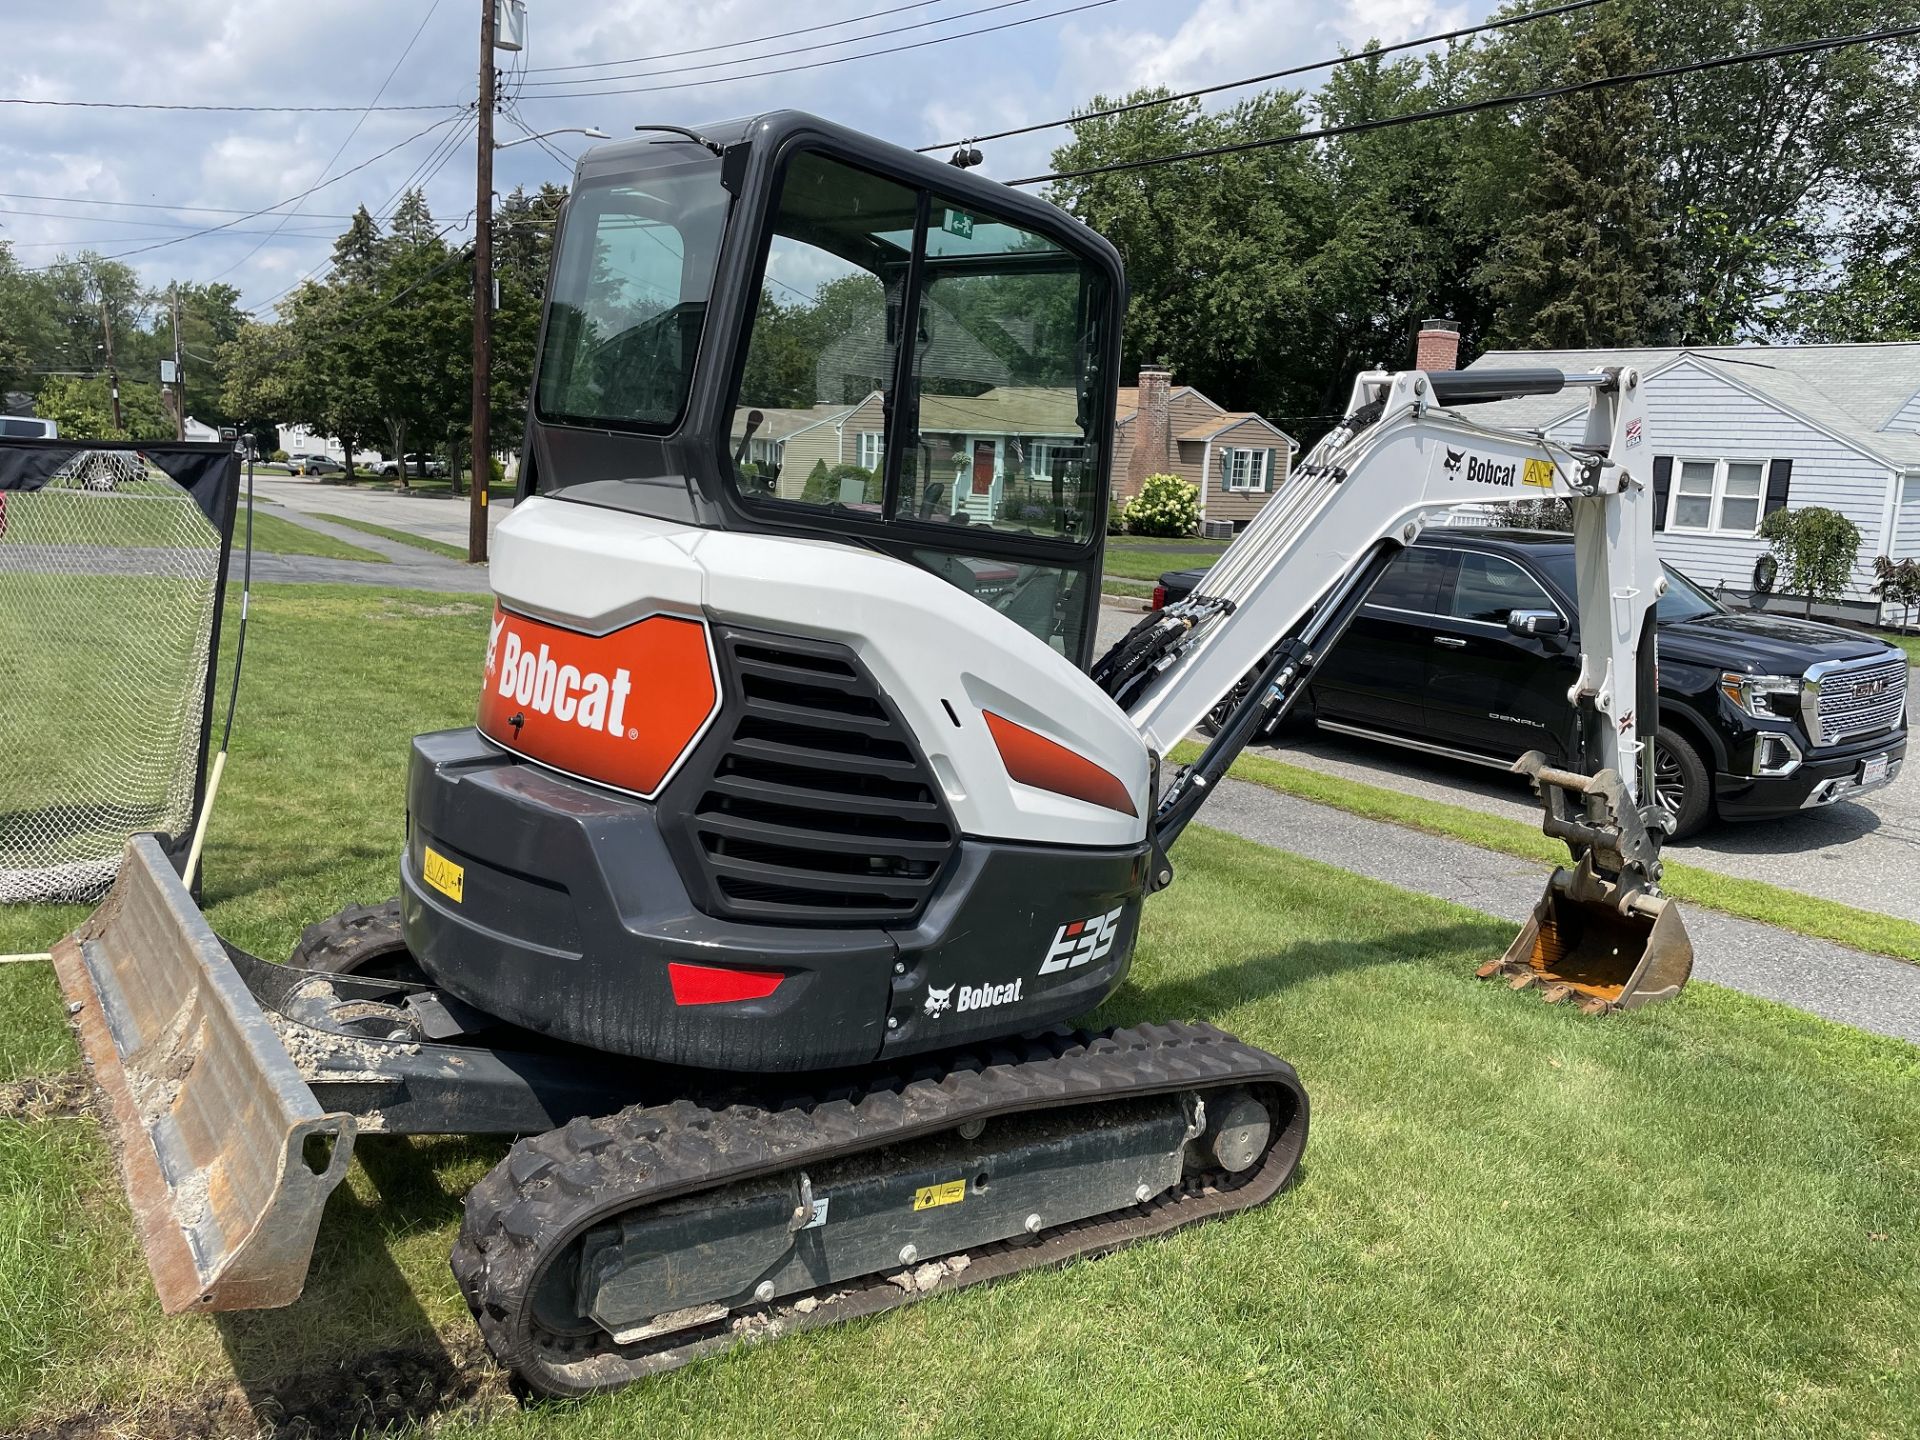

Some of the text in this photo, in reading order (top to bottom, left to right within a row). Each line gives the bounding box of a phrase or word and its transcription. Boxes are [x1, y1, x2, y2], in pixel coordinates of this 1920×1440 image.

[1626, 436, 1642, 448] USA
[1466, 456, 1516, 488] Bobcat
[498, 631, 632, 738] Bobcat
[1852, 676, 1890, 698] GMC
[1488, 712, 1545, 728] DENALI
[1038, 904, 1123, 976] E35
[957, 978, 1023, 1012] Bobcat
